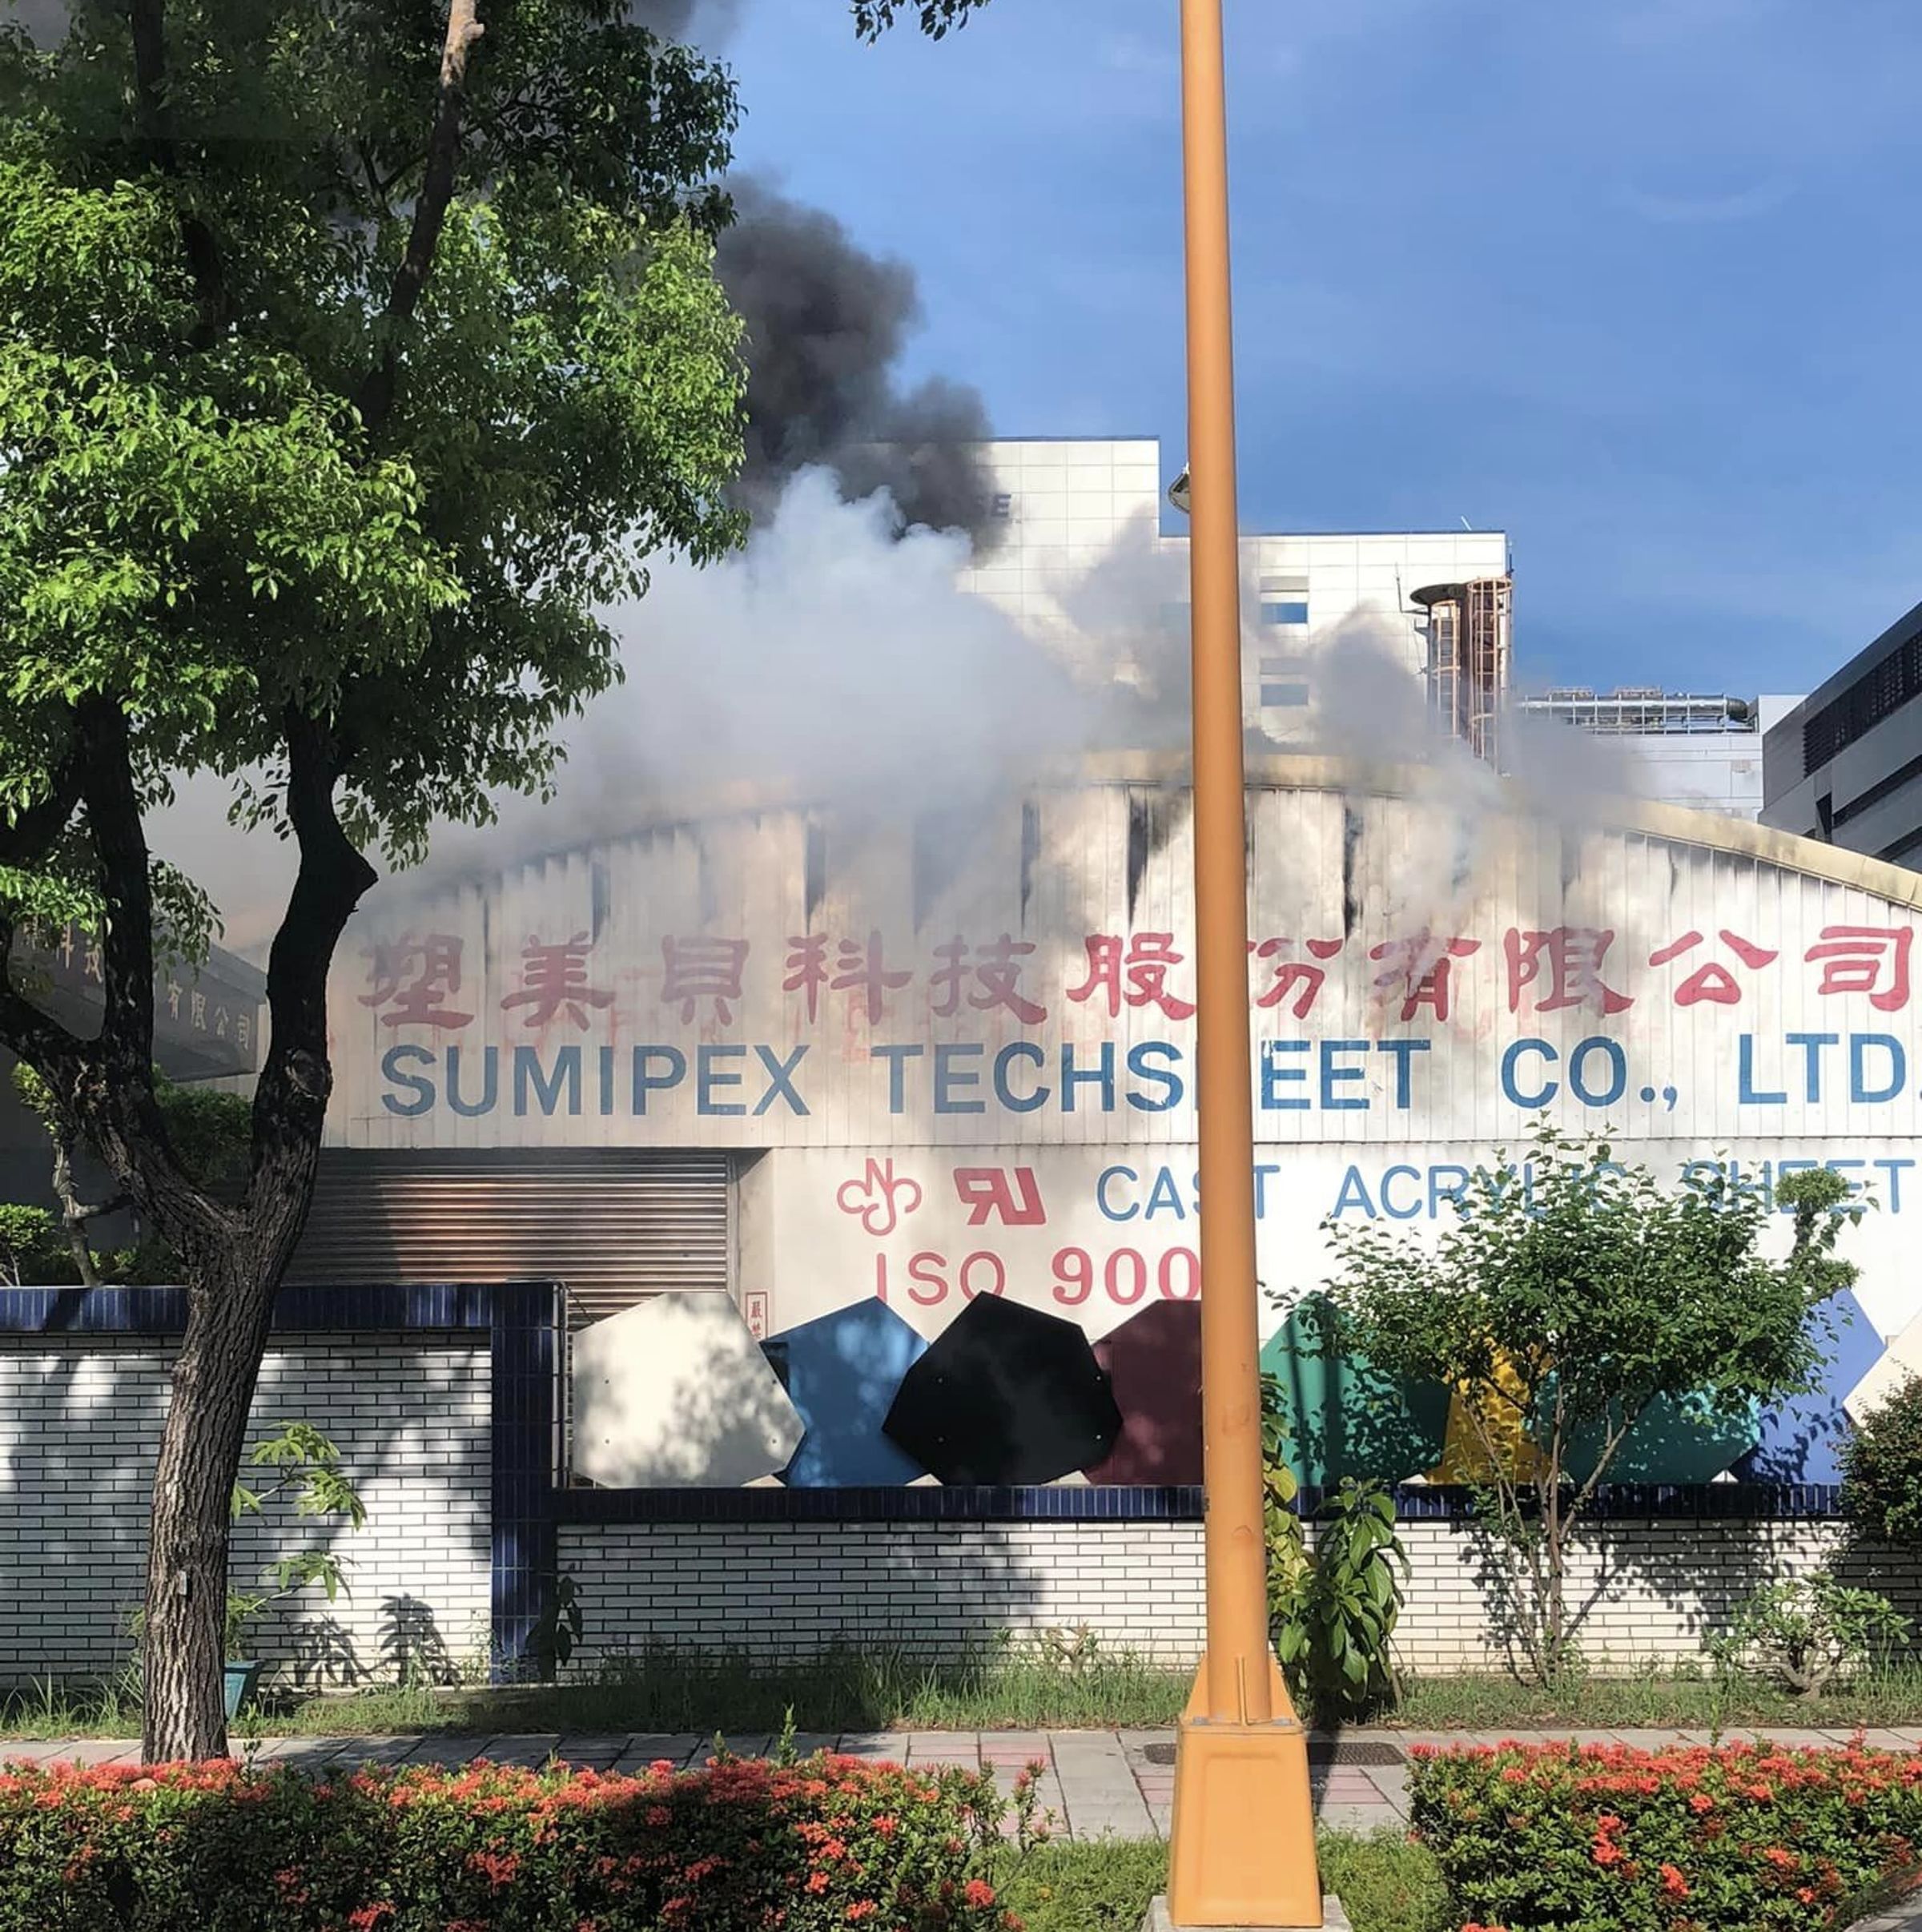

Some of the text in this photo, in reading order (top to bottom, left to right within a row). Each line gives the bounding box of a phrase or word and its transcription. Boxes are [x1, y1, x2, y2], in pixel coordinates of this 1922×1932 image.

[380, 1032, 1922, 1117] SUMIPEX TECHSEET CO., LTD
[1097, 1164, 1281, 1221] CAT
[876, 1251, 1005, 1306] ISO
